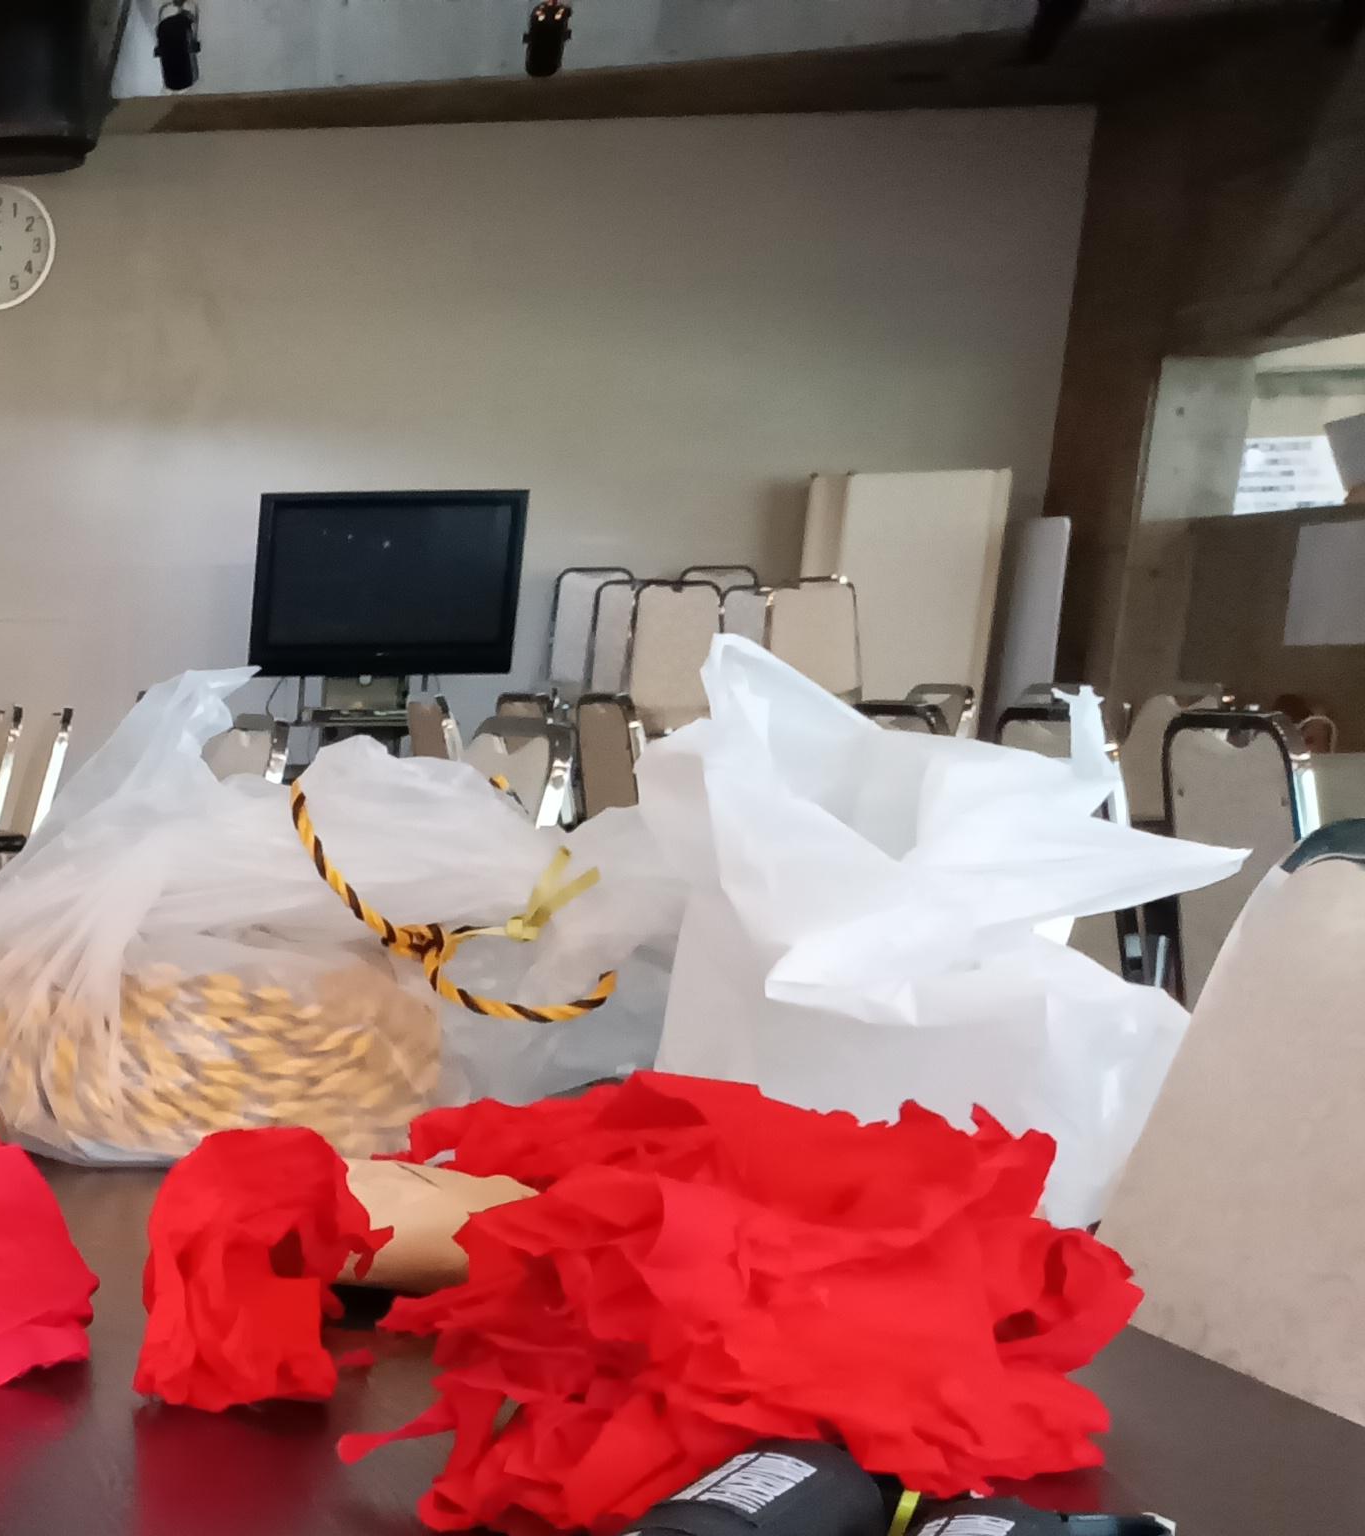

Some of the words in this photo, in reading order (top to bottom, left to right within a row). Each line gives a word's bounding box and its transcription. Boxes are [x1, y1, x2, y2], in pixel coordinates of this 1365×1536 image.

[12, 202, 18, 218] 1
[24, 215, 35, 233] 2
[32, 237, 42, 254] 3
[24, 259, 33, 275] 4
[9, 274, 20, 291] 5
